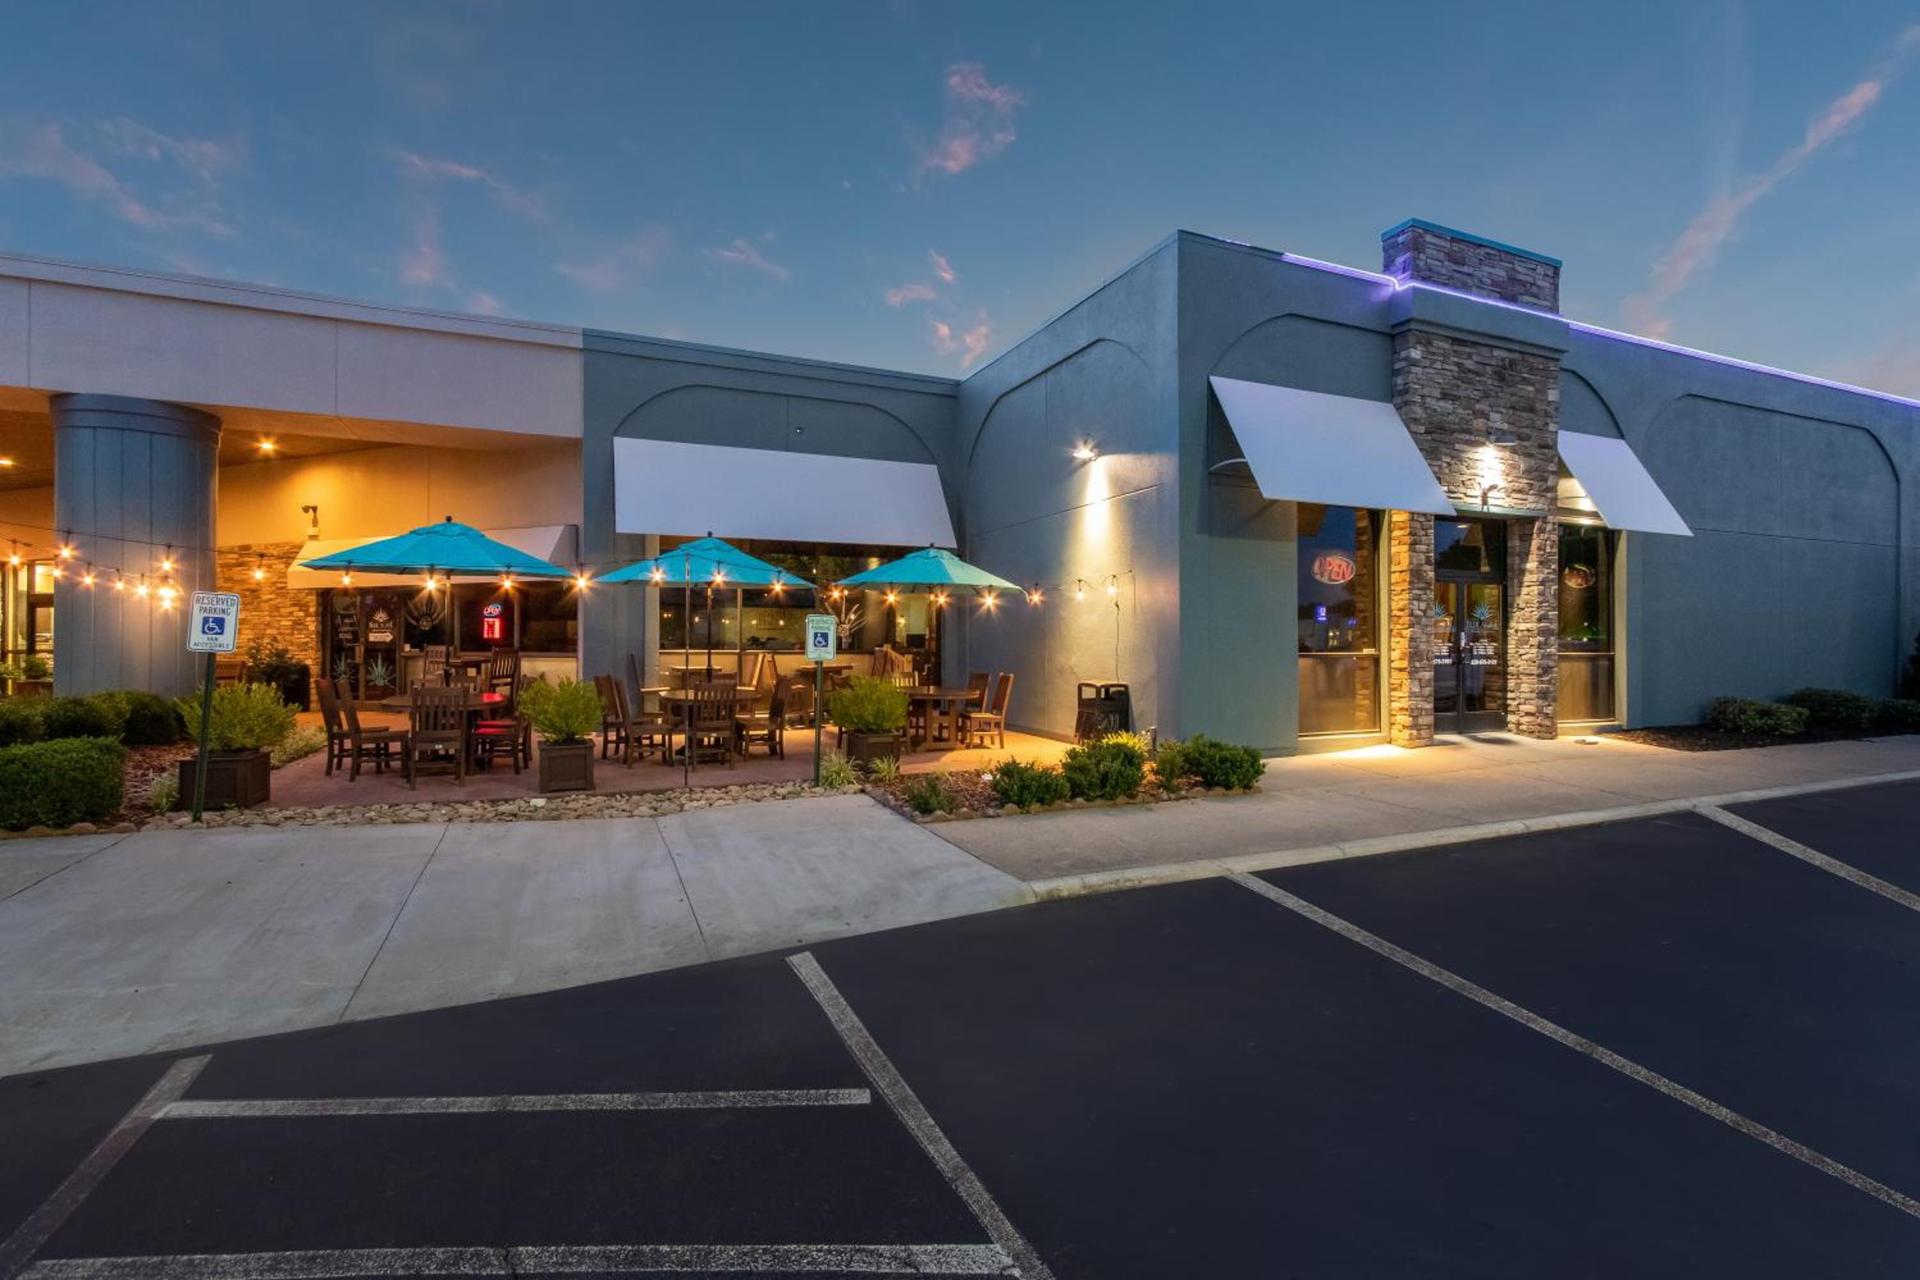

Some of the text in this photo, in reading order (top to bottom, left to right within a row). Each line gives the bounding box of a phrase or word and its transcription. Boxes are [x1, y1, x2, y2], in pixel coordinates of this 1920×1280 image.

[1314, 558, 1352, 580] OPEN
[195, 595, 236, 608] RESERVED
[199, 606, 231, 616] PARKING
